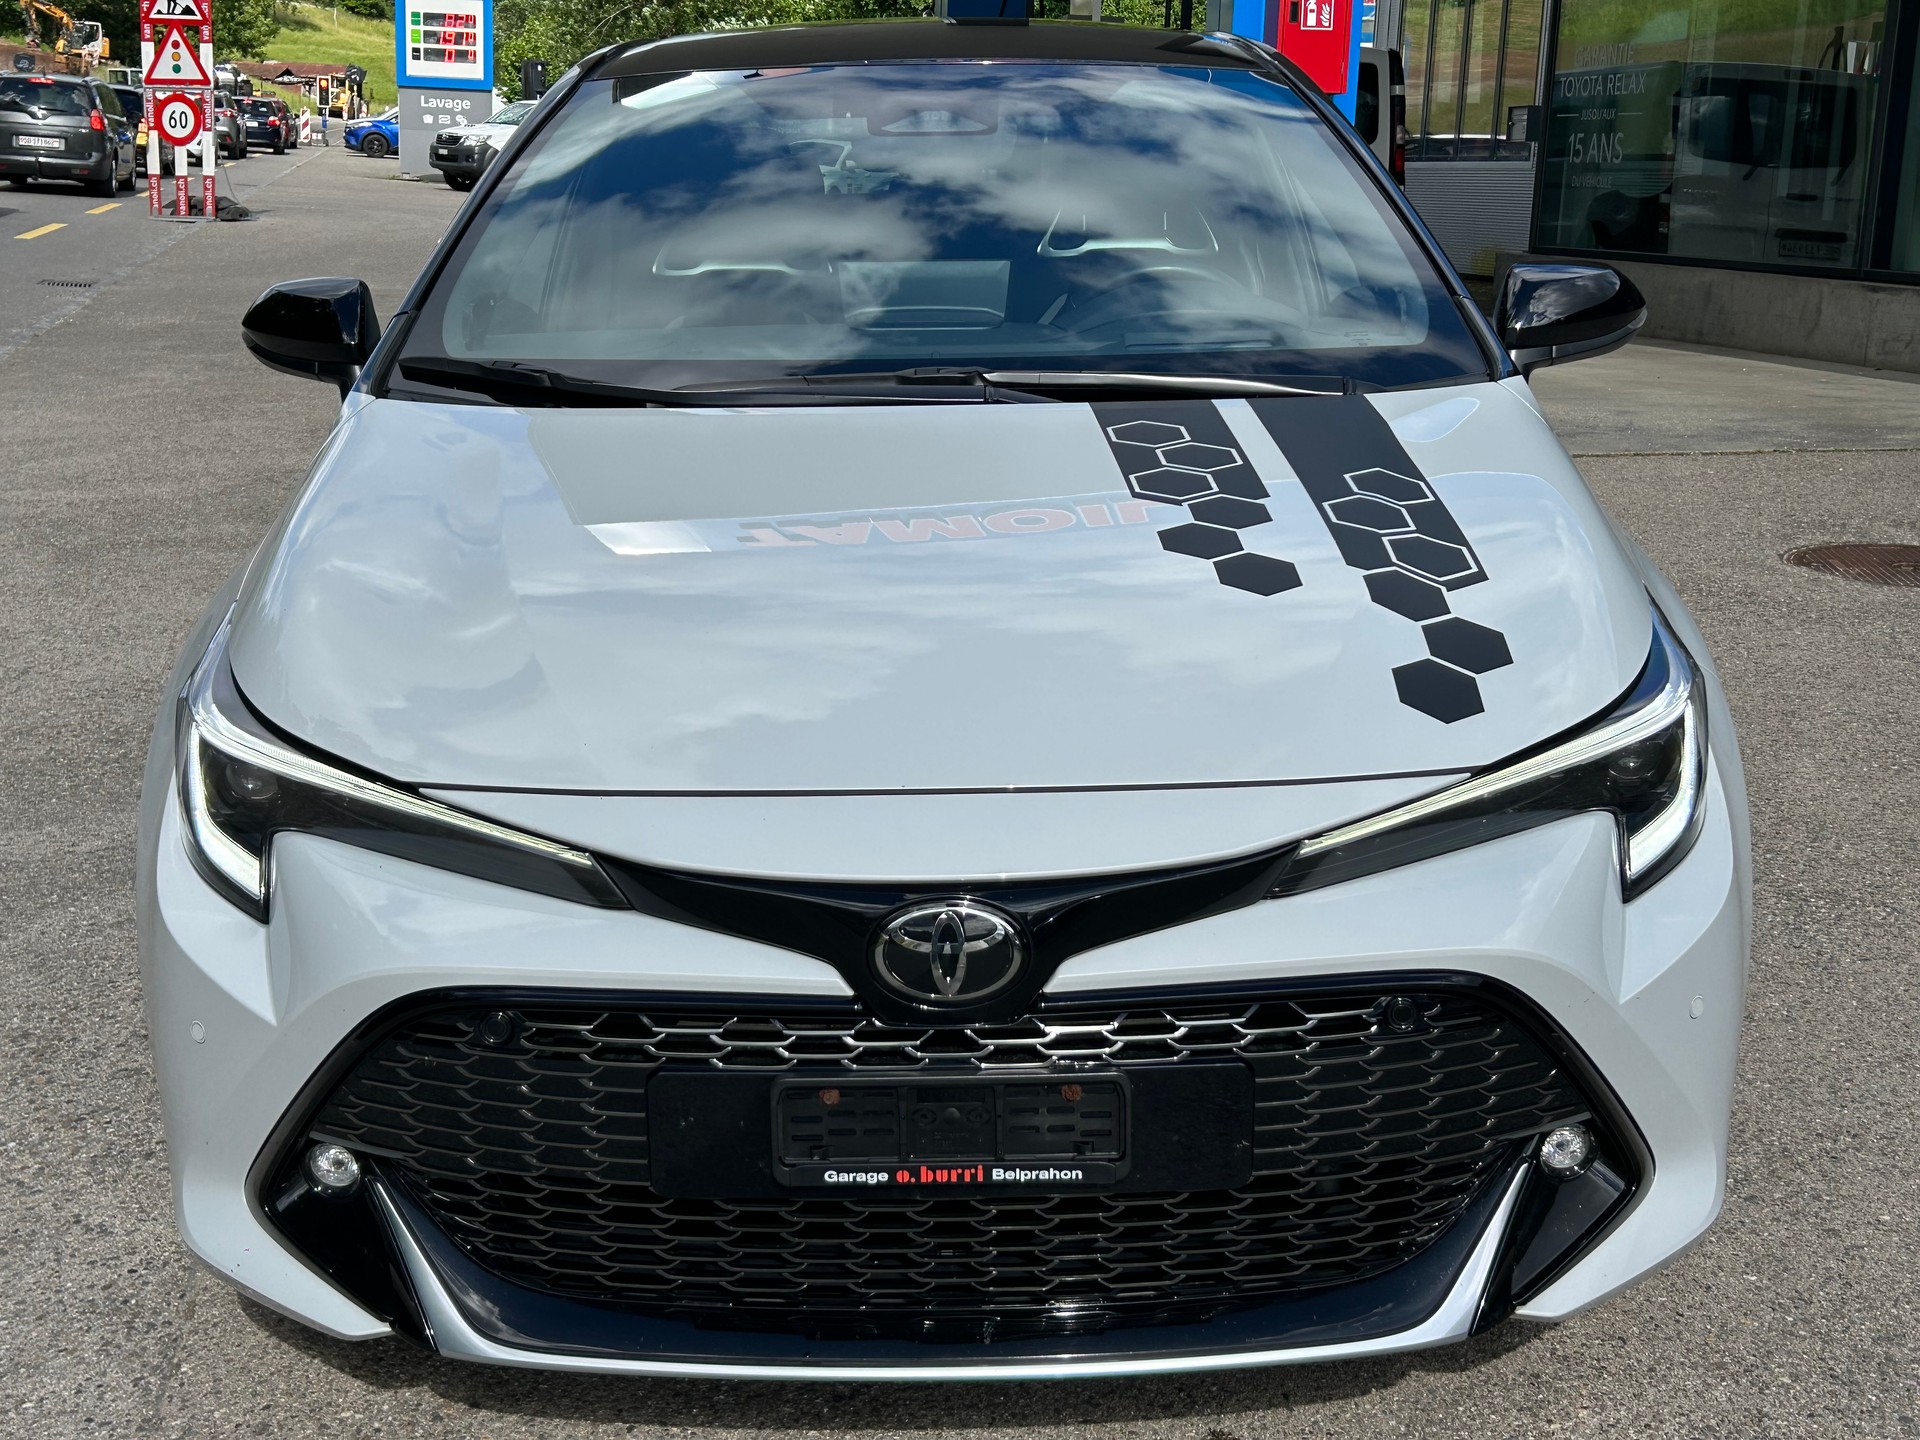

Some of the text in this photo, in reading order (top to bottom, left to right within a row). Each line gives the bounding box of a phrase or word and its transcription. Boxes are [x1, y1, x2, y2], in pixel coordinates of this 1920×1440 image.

[1574, 42, 1634, 66] GARANTIE
[1560, 72, 1647, 98] TOYOTA RELAX
[420, 95, 471, 110] Lavage
[168, 110, 188, 129] 60
[1568, 132, 1624, 164] 15 ANS
[177, 178, 186, 215] vanoli.ch
[823, 1170, 889, 1184] Garage
[992, 1168, 1083, 1182] Belprahon
